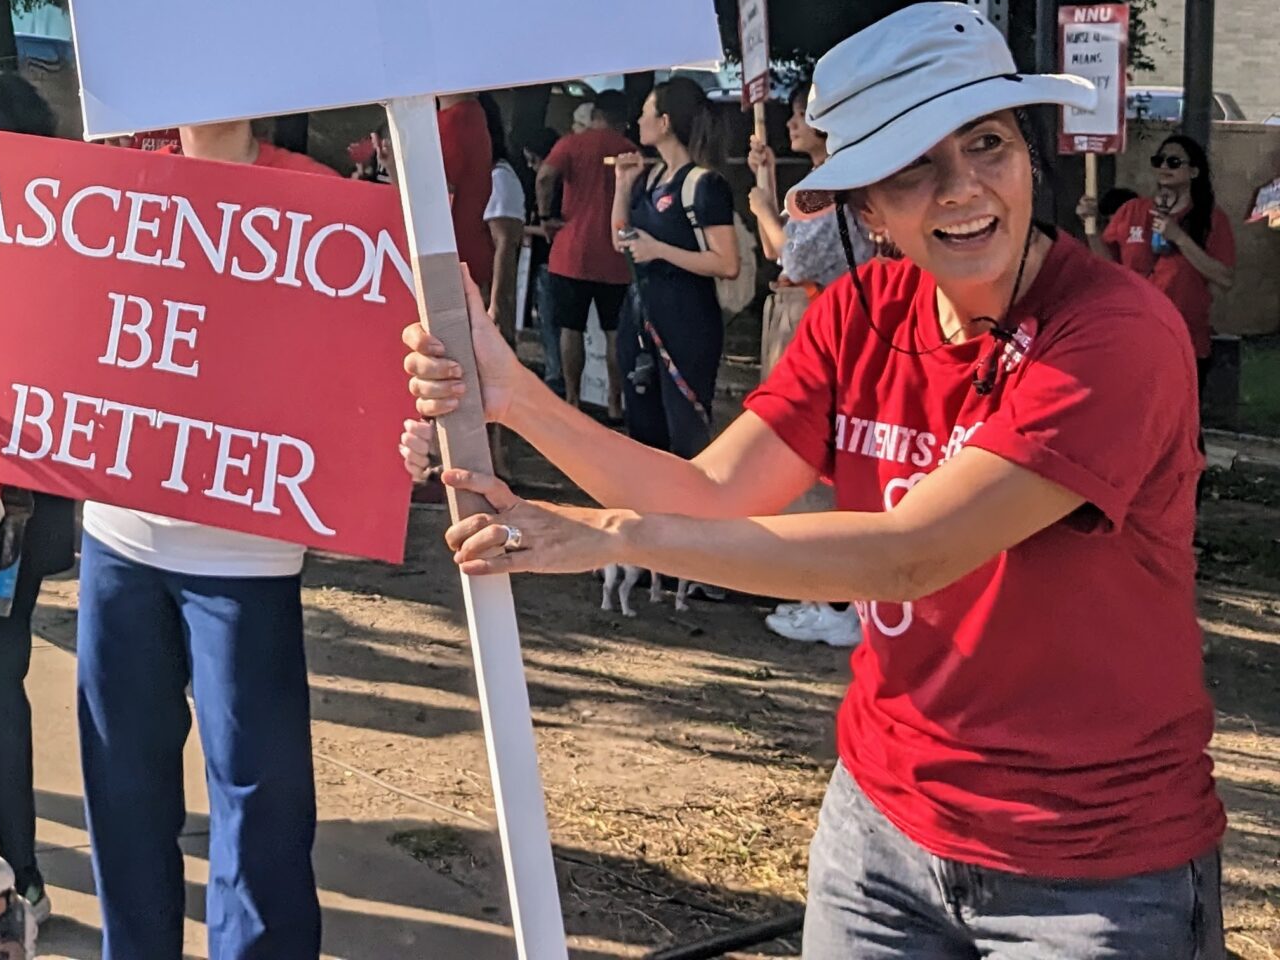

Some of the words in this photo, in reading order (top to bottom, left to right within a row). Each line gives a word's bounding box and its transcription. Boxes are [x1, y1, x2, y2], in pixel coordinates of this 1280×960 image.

[1073, 7, 1112, 23] NNU
[98, 292, 206, 378] BE
[1, 384, 337, 536] BETTER
[835, 413, 937, 467] ATIENTS
